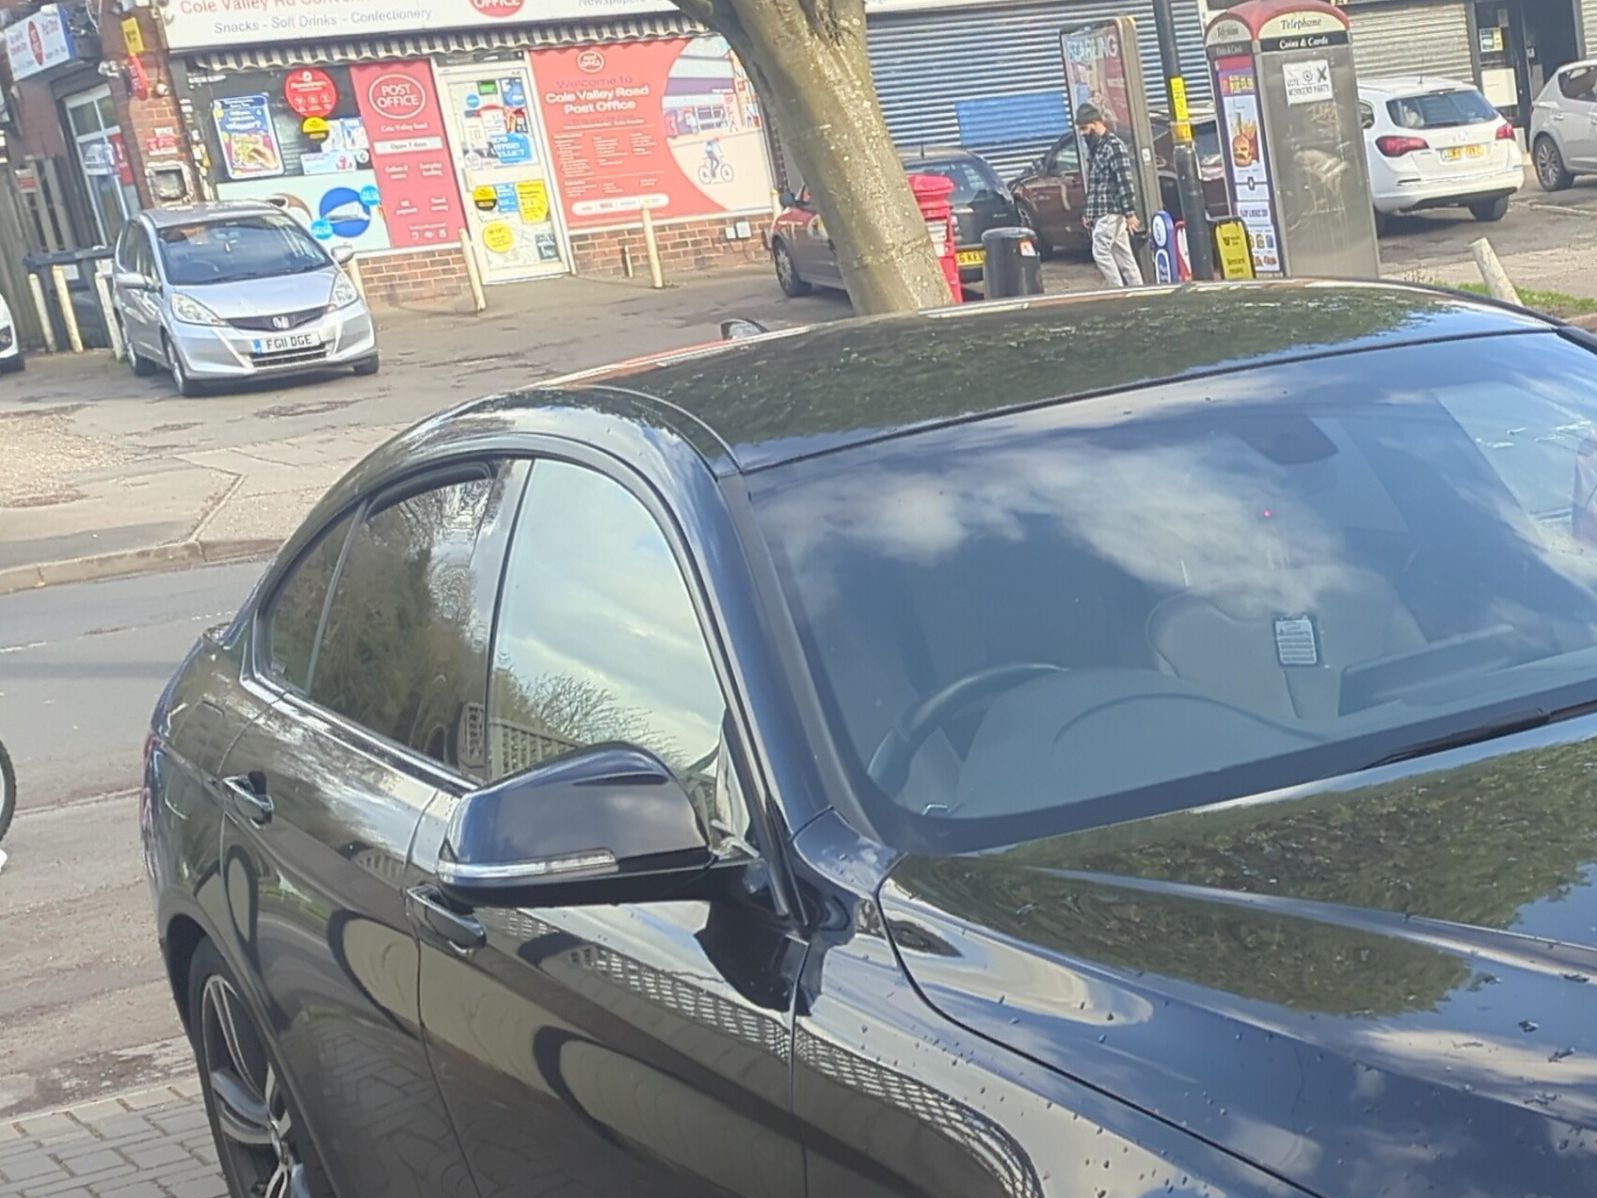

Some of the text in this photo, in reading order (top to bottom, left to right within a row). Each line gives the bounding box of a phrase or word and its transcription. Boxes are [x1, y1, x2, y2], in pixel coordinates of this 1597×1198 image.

[180, 0, 206, 14] Cole
[221, 0, 268, 11] Valley
[214, 21, 259, 34] Snacks
[299, 14, 337, 28] Drinks
[351, 9, 432, 24] Confectionery
[1280, 16, 1322, 30] Telephone
[381, 84, 412, 96] POST
[556, 76, 633, 90] Welcome to
[377, 94, 420, 108] OFFICE
[545, 84, 649, 104] Cole Valley Road
[563, 99, 637, 114] Post Office
[266, 334, 312, 350] FG11 DGE
